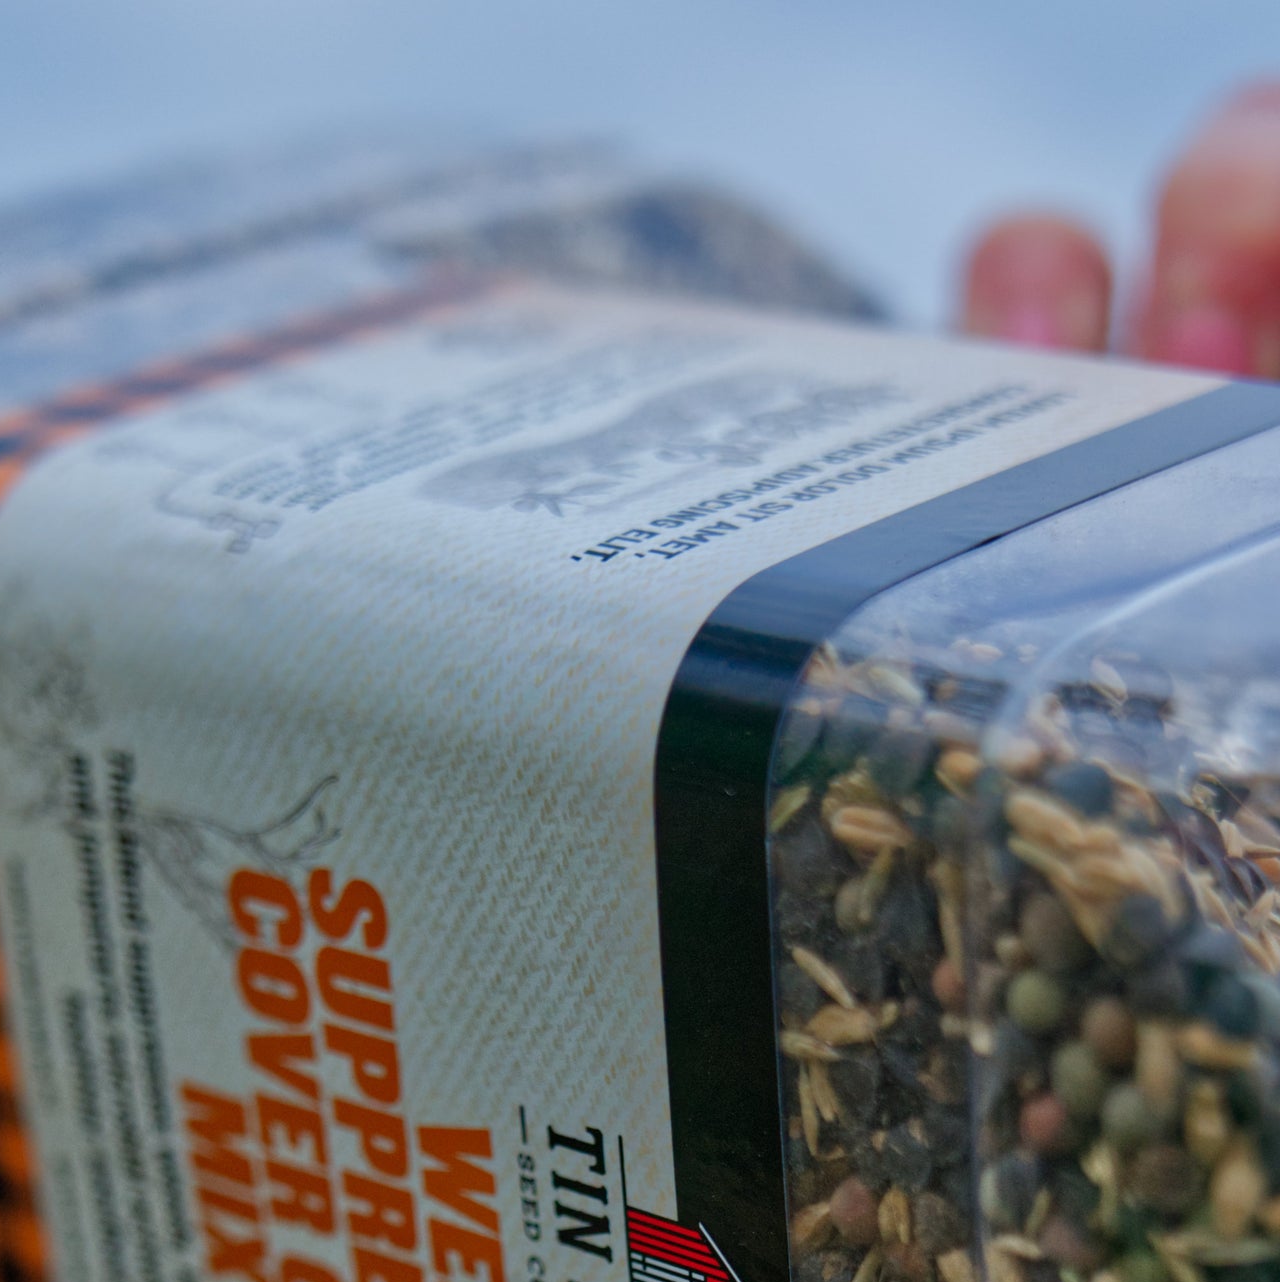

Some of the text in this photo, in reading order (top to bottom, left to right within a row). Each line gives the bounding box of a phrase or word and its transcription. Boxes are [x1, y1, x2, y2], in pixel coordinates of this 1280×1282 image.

[879, 426, 984, 464] IPSUM
[650, 462, 819, 530] ADIPISCING
[782, 463, 892, 502] DOLOR
[735, 500, 794, 522] SIT
[570, 527, 660, 562] ELIT,
[634, 519, 741, 560] AMET,
[228, 867, 336, 1237] COVER
[517, 1151, 541, 1243] SEED
[547, 1125, 613, 1264] TIN
